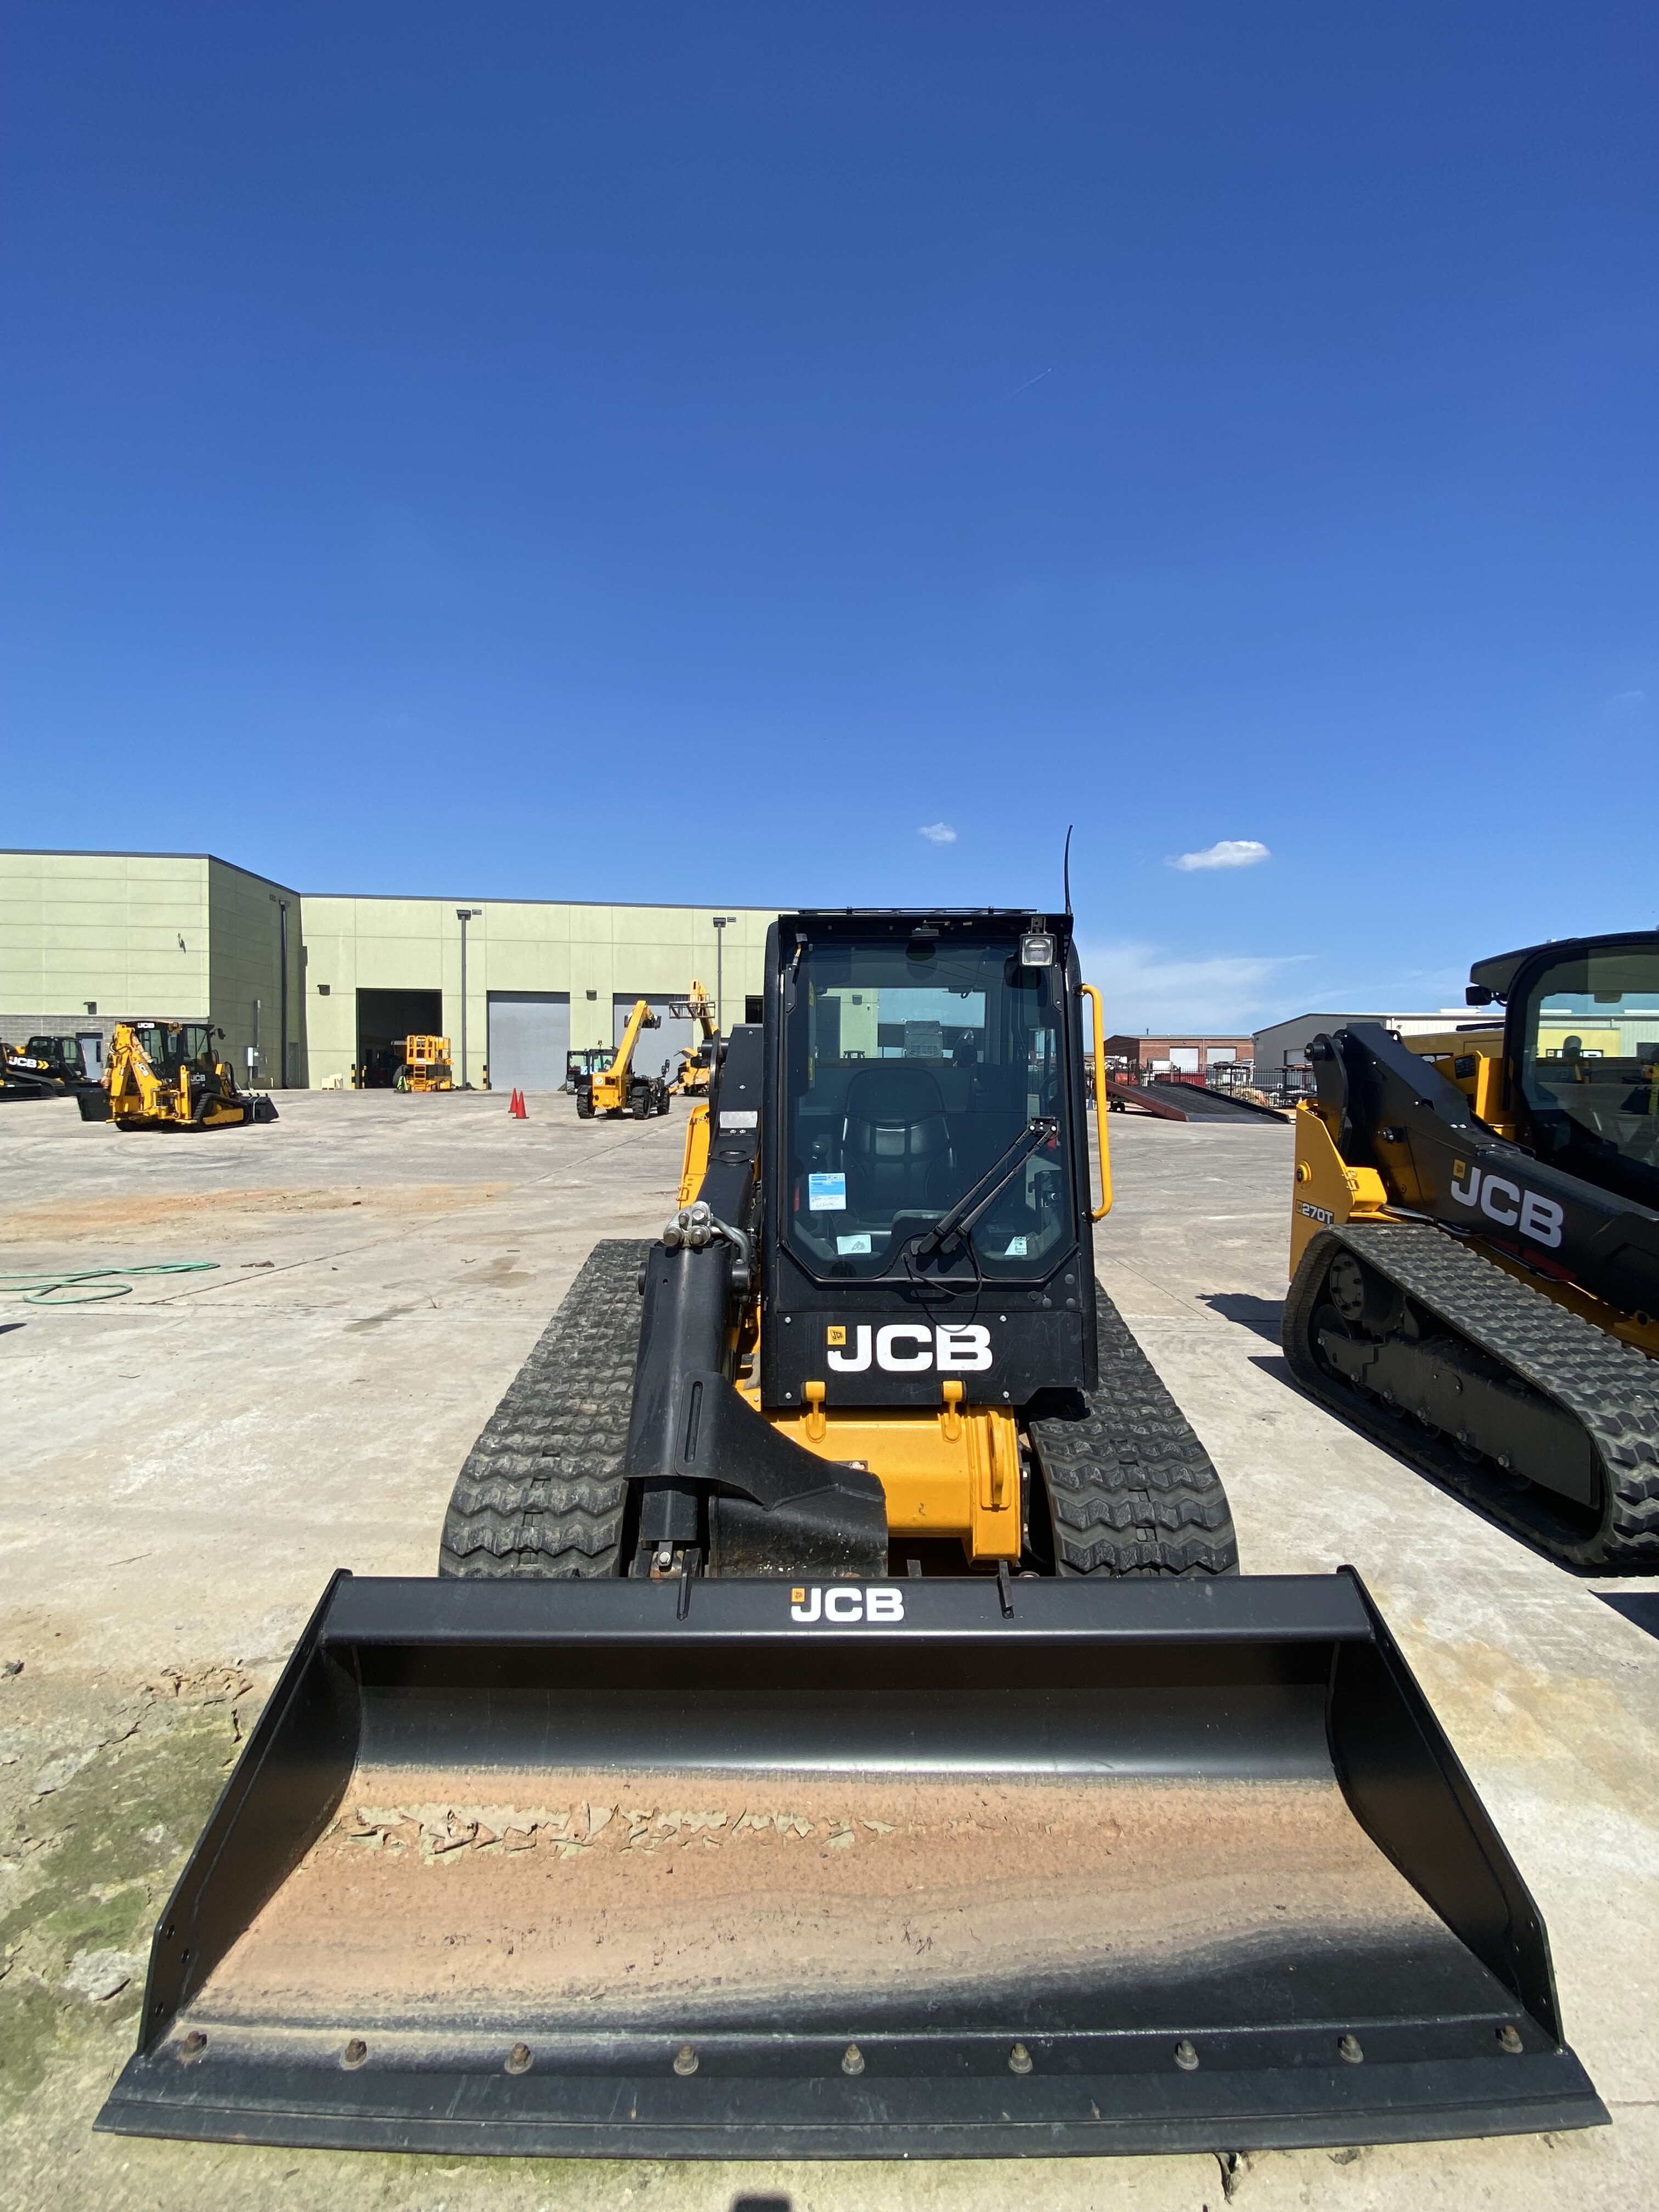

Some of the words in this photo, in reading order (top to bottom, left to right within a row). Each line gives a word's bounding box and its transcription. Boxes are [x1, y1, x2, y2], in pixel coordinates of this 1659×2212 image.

[8, 1057, 37, 1068] JCB
[1302, 1203, 1333, 1224] 270T
[1451, 1166, 1564, 1248] JCB
[827, 1324, 992, 1372] JCB
[791, 1587, 904, 1622] JCB
